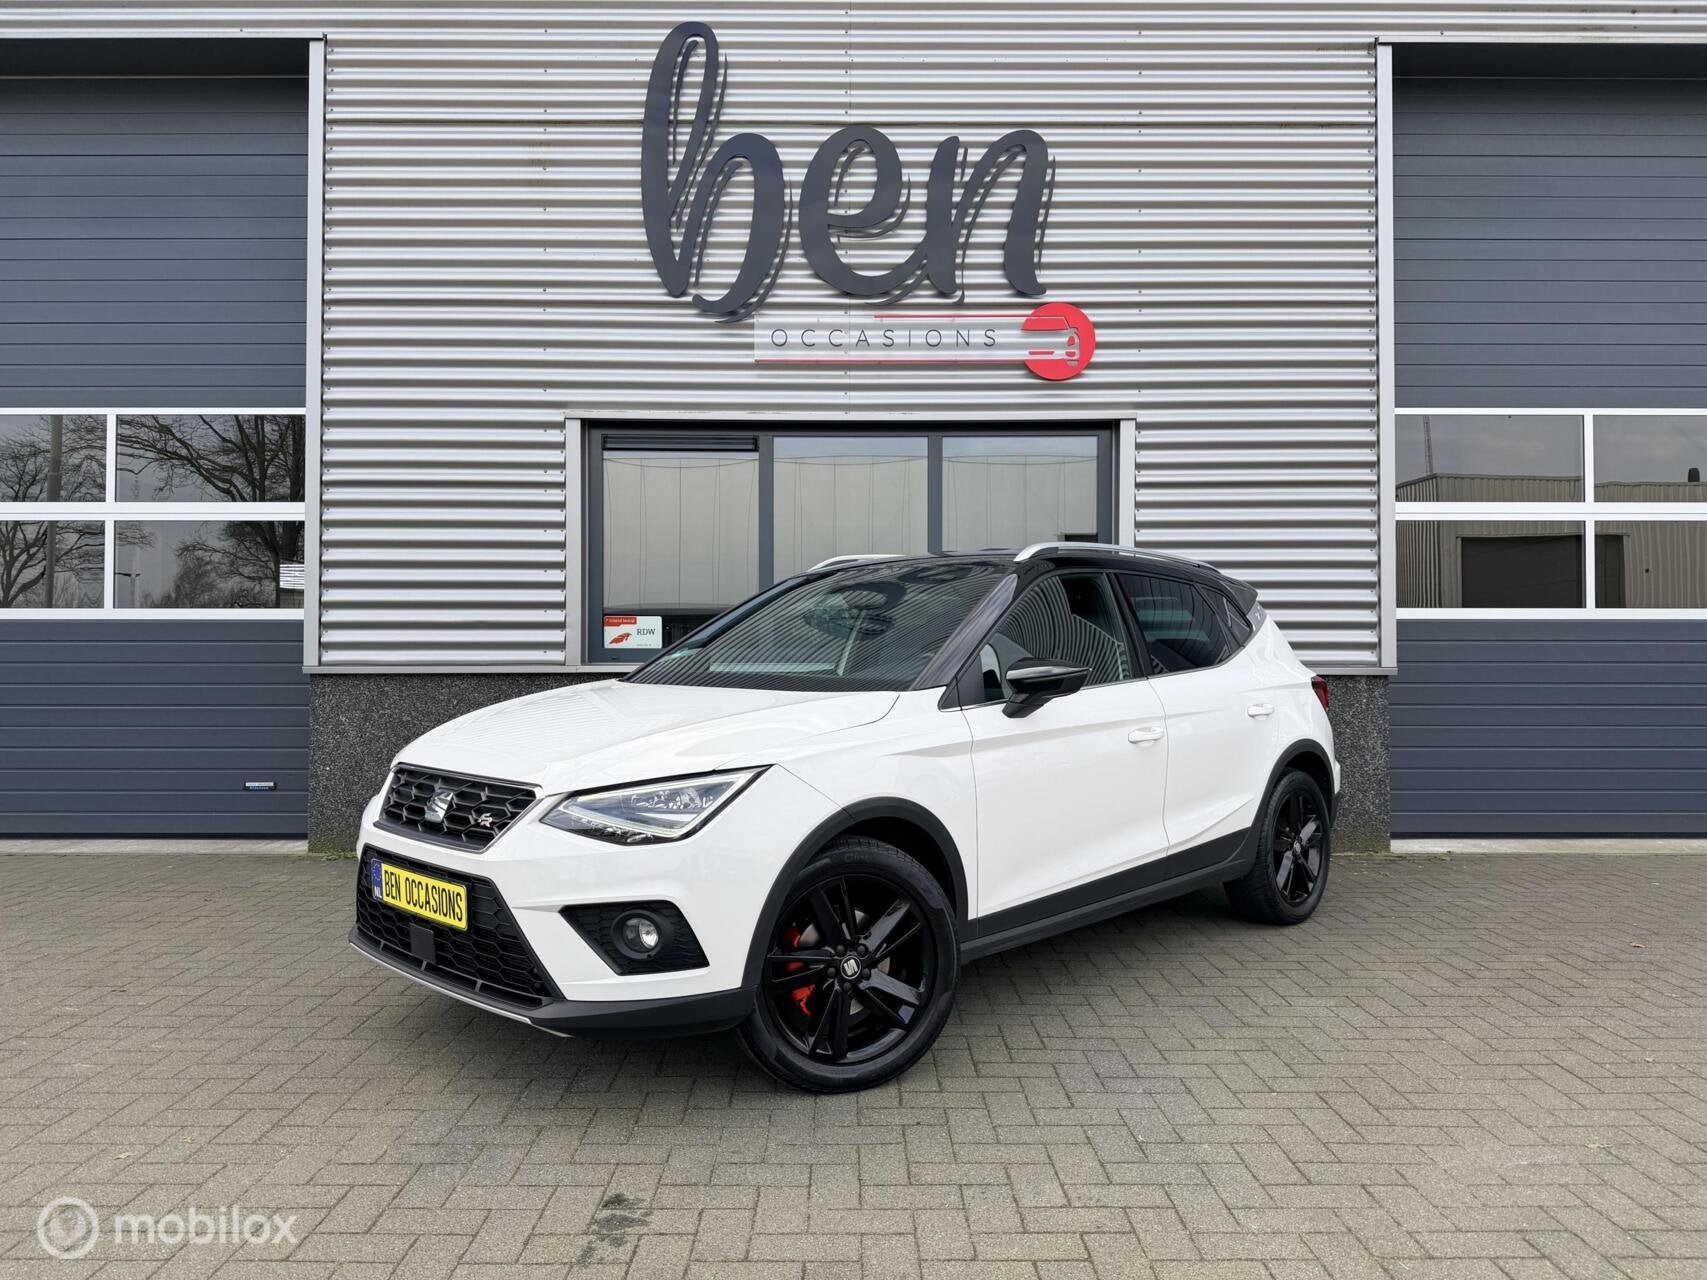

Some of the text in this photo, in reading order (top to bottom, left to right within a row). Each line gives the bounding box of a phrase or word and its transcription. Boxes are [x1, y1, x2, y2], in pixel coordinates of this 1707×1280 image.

[641, 21, 1050, 315] ben
[770, 328, 997, 348] OCCASIONS
[636, 628, 656, 636] RDW
[374, 886, 383, 899] NL
[384, 869, 463, 922] BEN OCCASIONS
